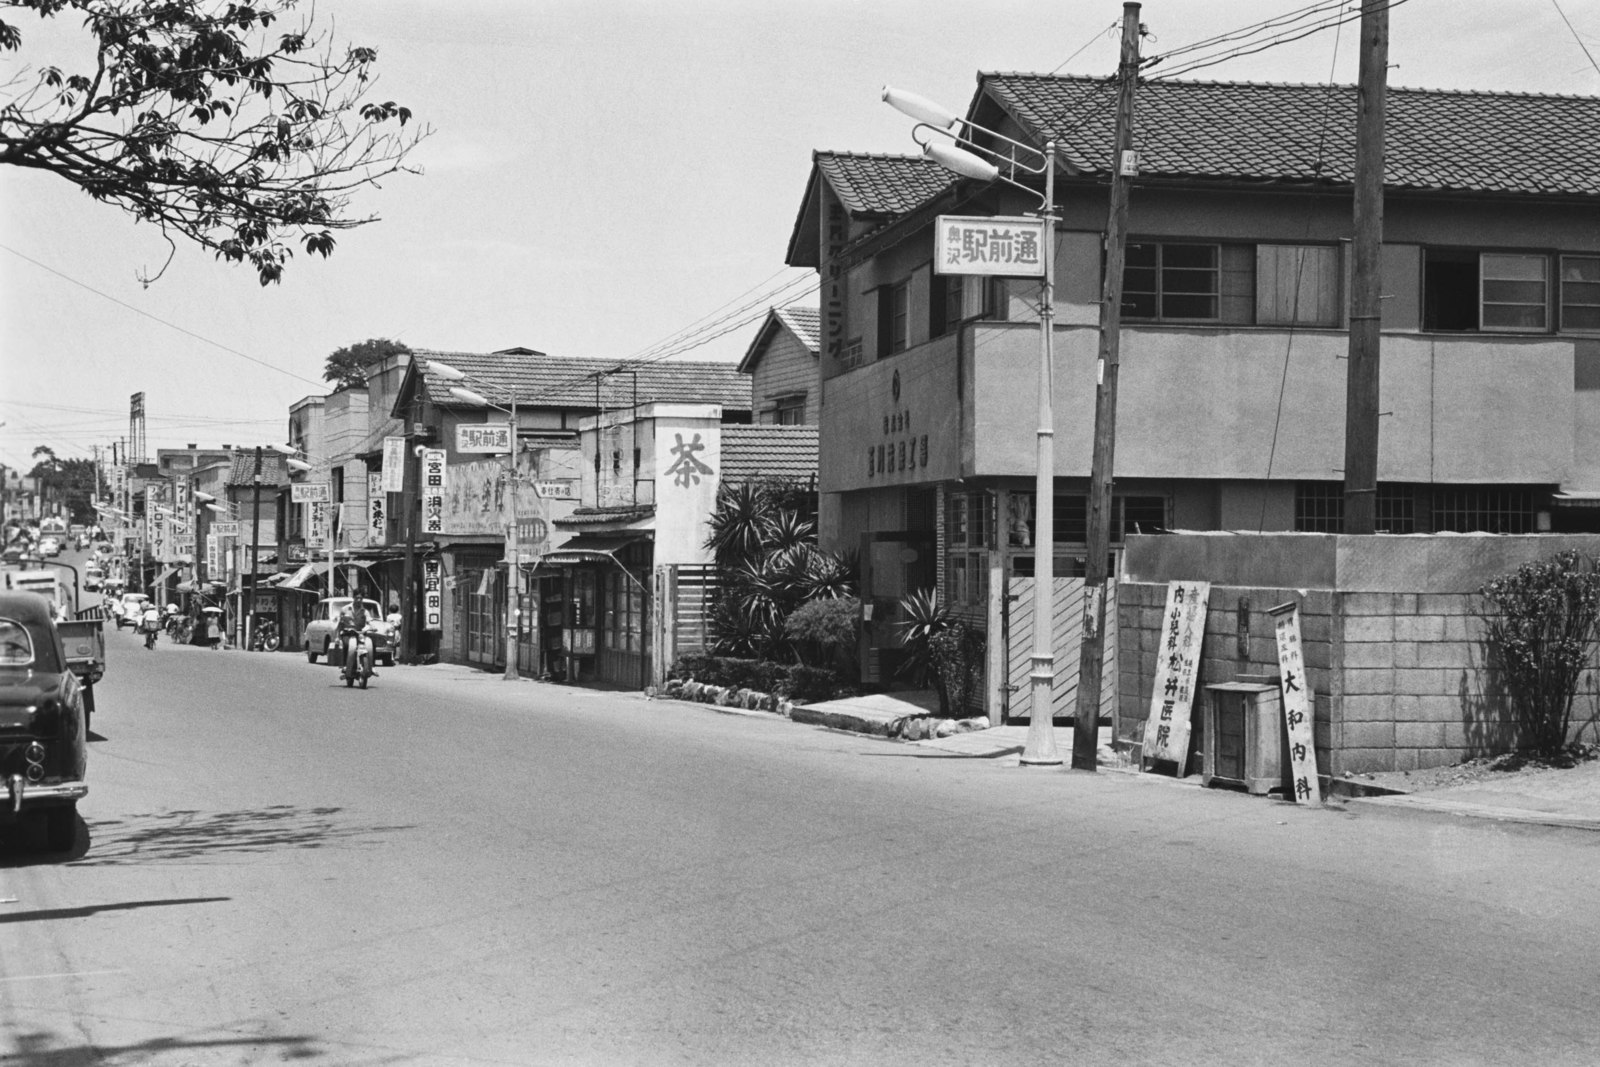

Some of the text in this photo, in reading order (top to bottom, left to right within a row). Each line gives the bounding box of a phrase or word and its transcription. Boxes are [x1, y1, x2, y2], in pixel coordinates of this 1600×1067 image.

[962, 228, 1039, 264] 駅前通
[469, 430, 508, 447] 駅前通
[428, 462, 442, 486] 宮田
[663, 432, 714, 489] 茶
[428, 496, 442, 532] 消火器
[1284, 670, 1313, 800] 大和内科
